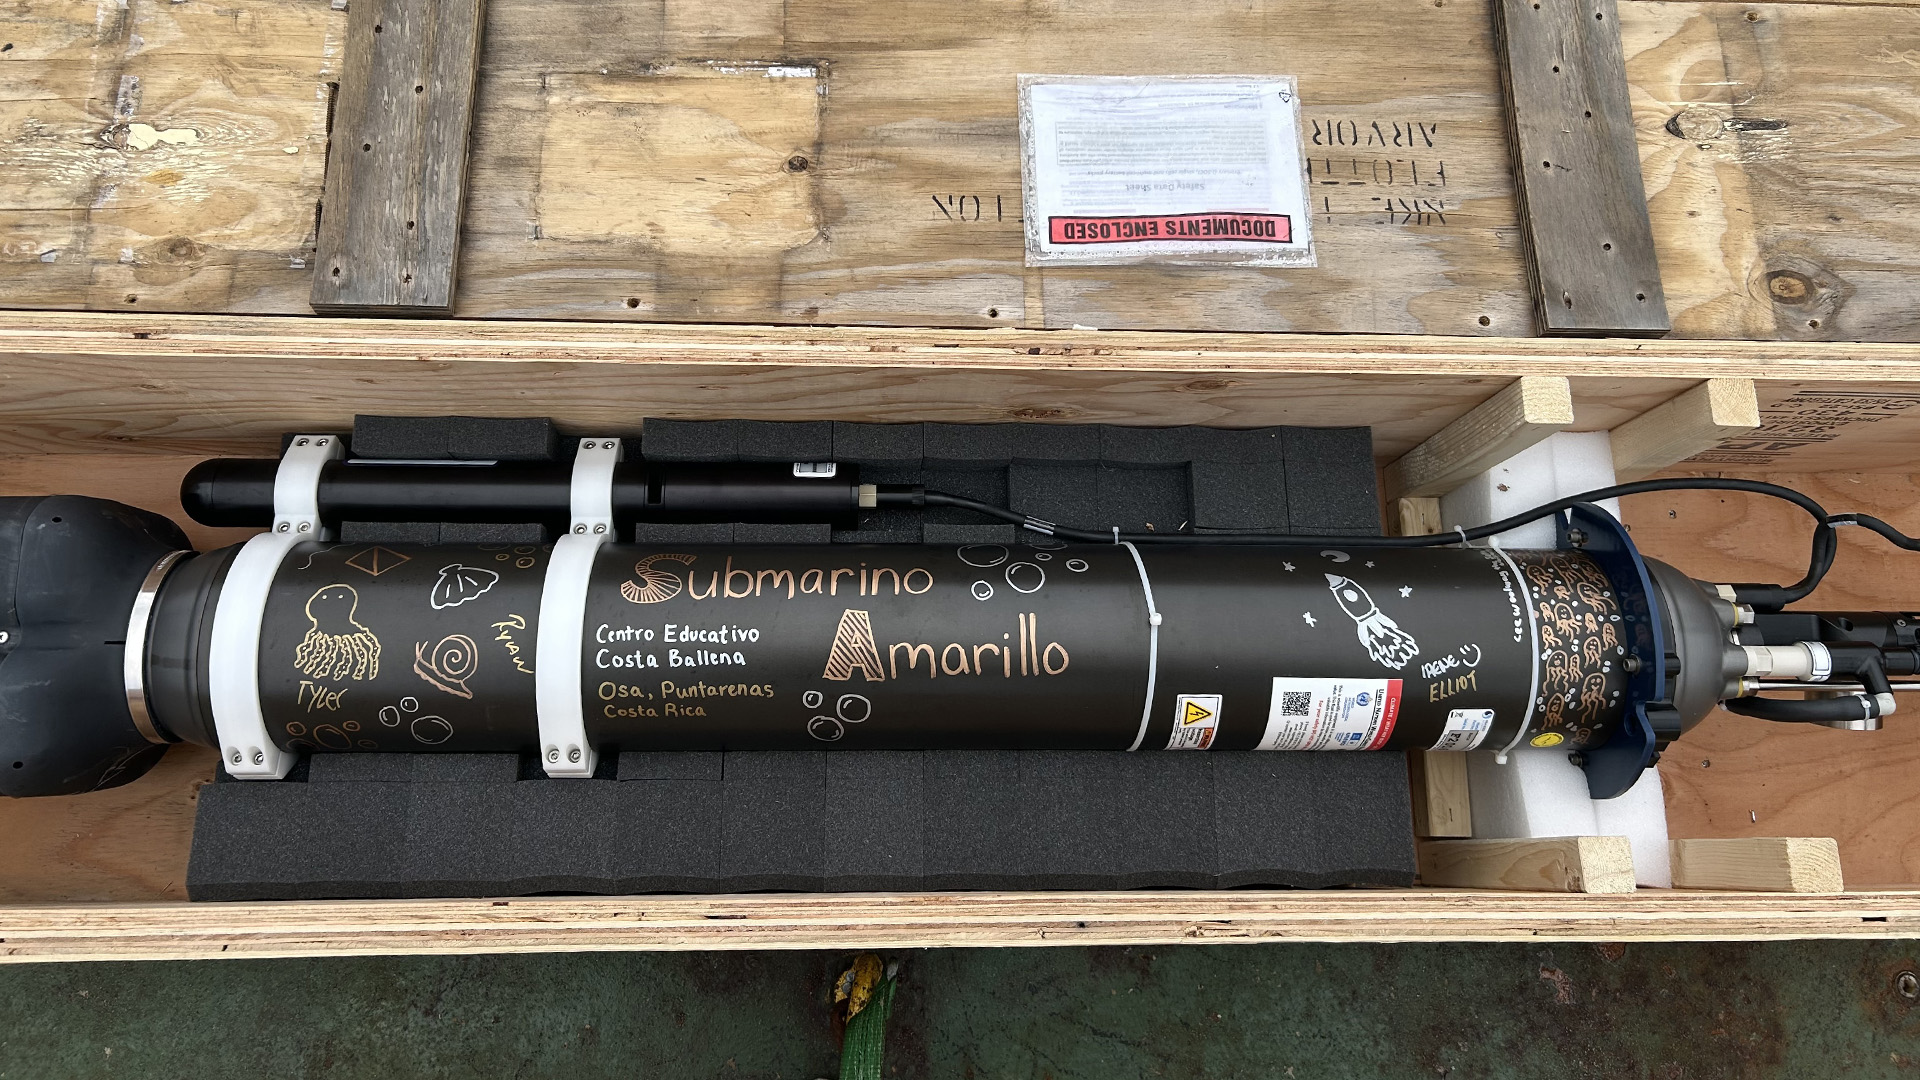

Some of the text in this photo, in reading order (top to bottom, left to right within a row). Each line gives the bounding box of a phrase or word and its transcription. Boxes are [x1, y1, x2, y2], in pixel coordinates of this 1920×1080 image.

[1312, 119, 1437, 147] ARVOR
[1125, 180, 1205, 191] Safety Data Sheet
[1063, 218, 1276, 239] DOCUMENTS ENCLOSED
[620, 553, 934, 604] Submarino
[595, 623, 761, 644] Centro Educativo
[822, 608, 1070, 682] Amarillo
[595, 648, 747, 669] Costa Ballena
[598, 680, 775, 701] Osa, Puntarenas
[1429, 669, 1477, 703] ELLIOT
[603, 702, 707, 718] Costa Rica
[1387, 697, 1396, 717] CLIMATE
